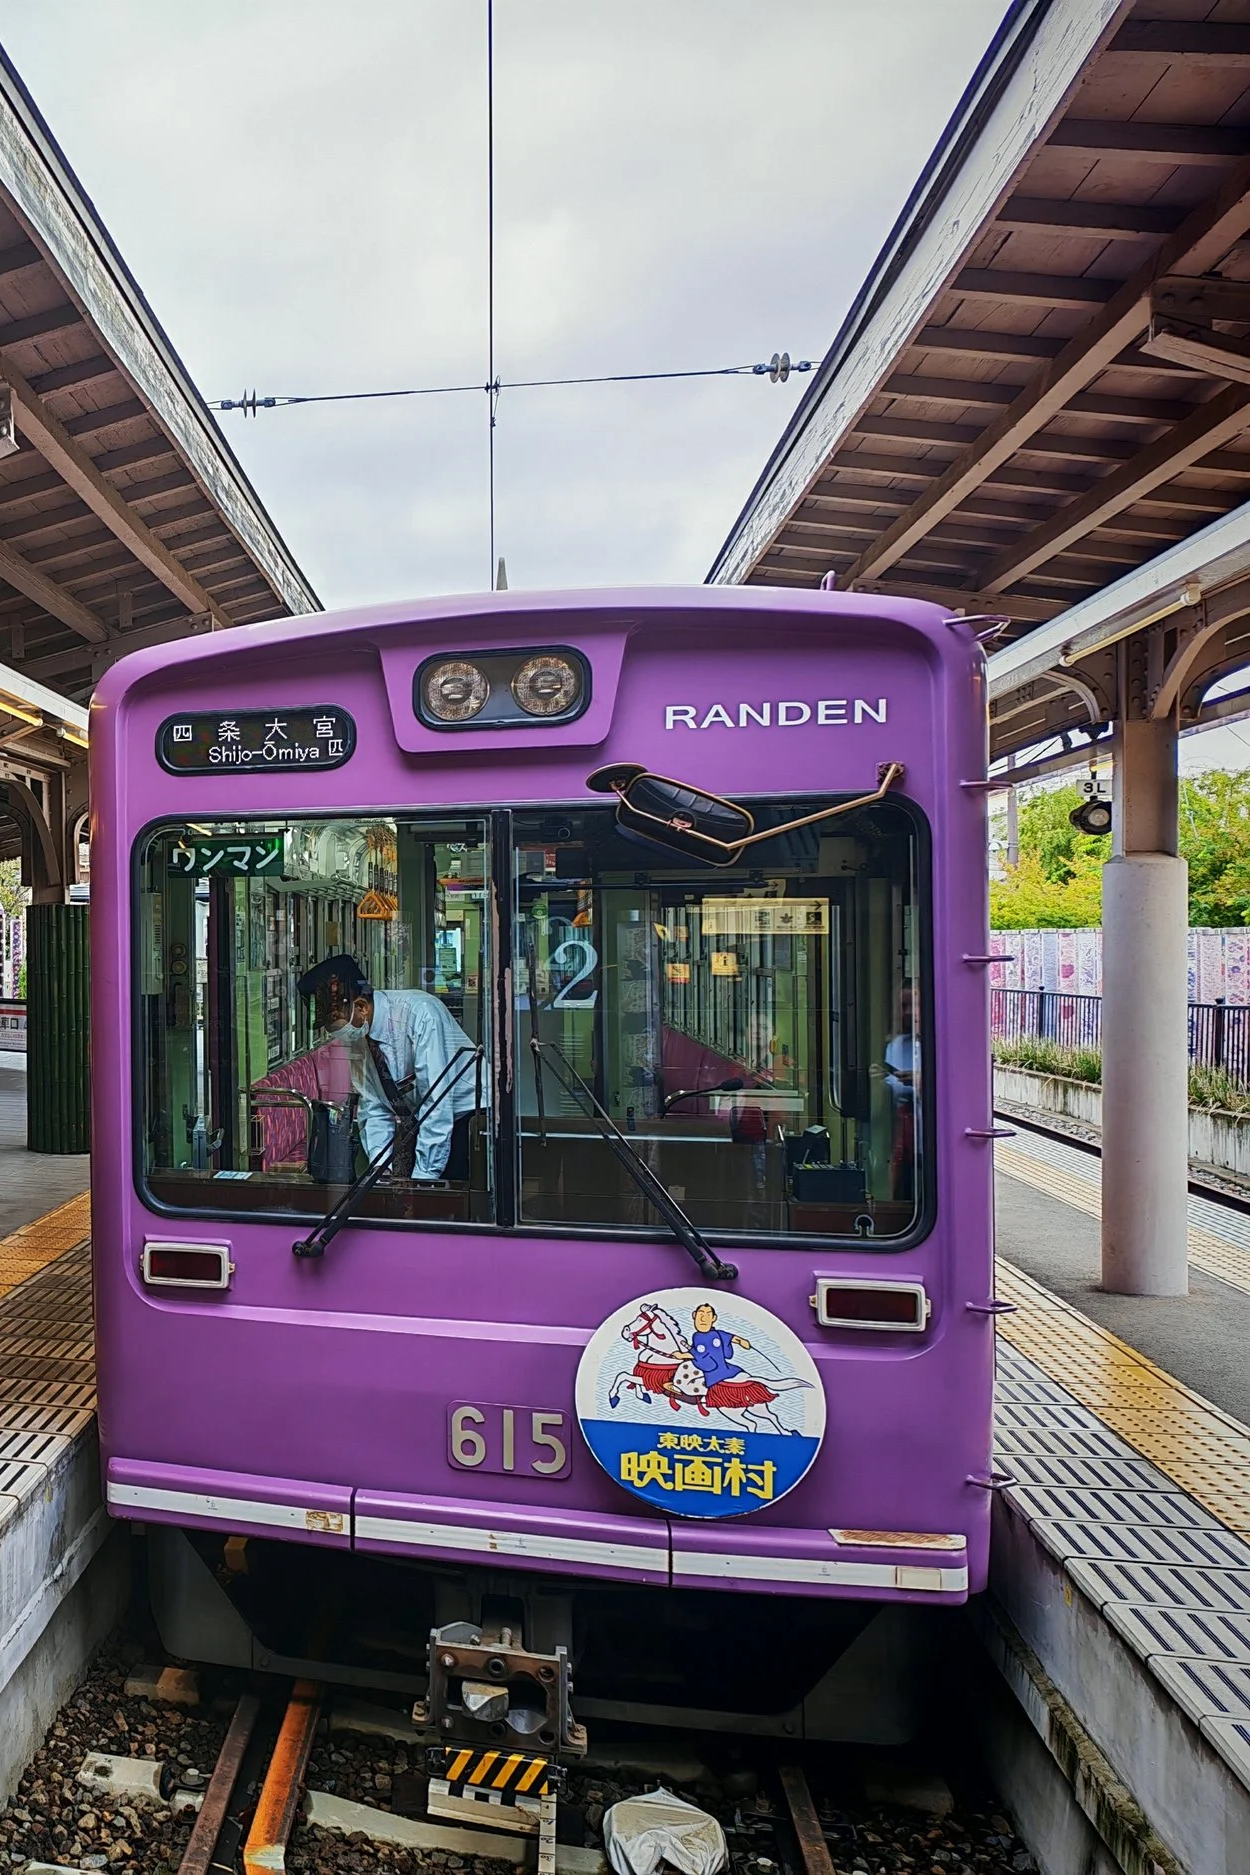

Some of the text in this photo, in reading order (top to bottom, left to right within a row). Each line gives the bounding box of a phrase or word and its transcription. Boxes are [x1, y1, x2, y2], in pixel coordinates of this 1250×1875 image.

[665, 699, 887, 730] RANDEN
[173, 716, 336, 742] 四条大宮
[1083, 782, 1107, 793] 3L
[172, 846, 279, 872] ワンマン
[451, 1406, 567, 1474] 615
[657, 1432, 746, 1455] 東映太秦
[620, 1451, 777, 1500] 映画村
